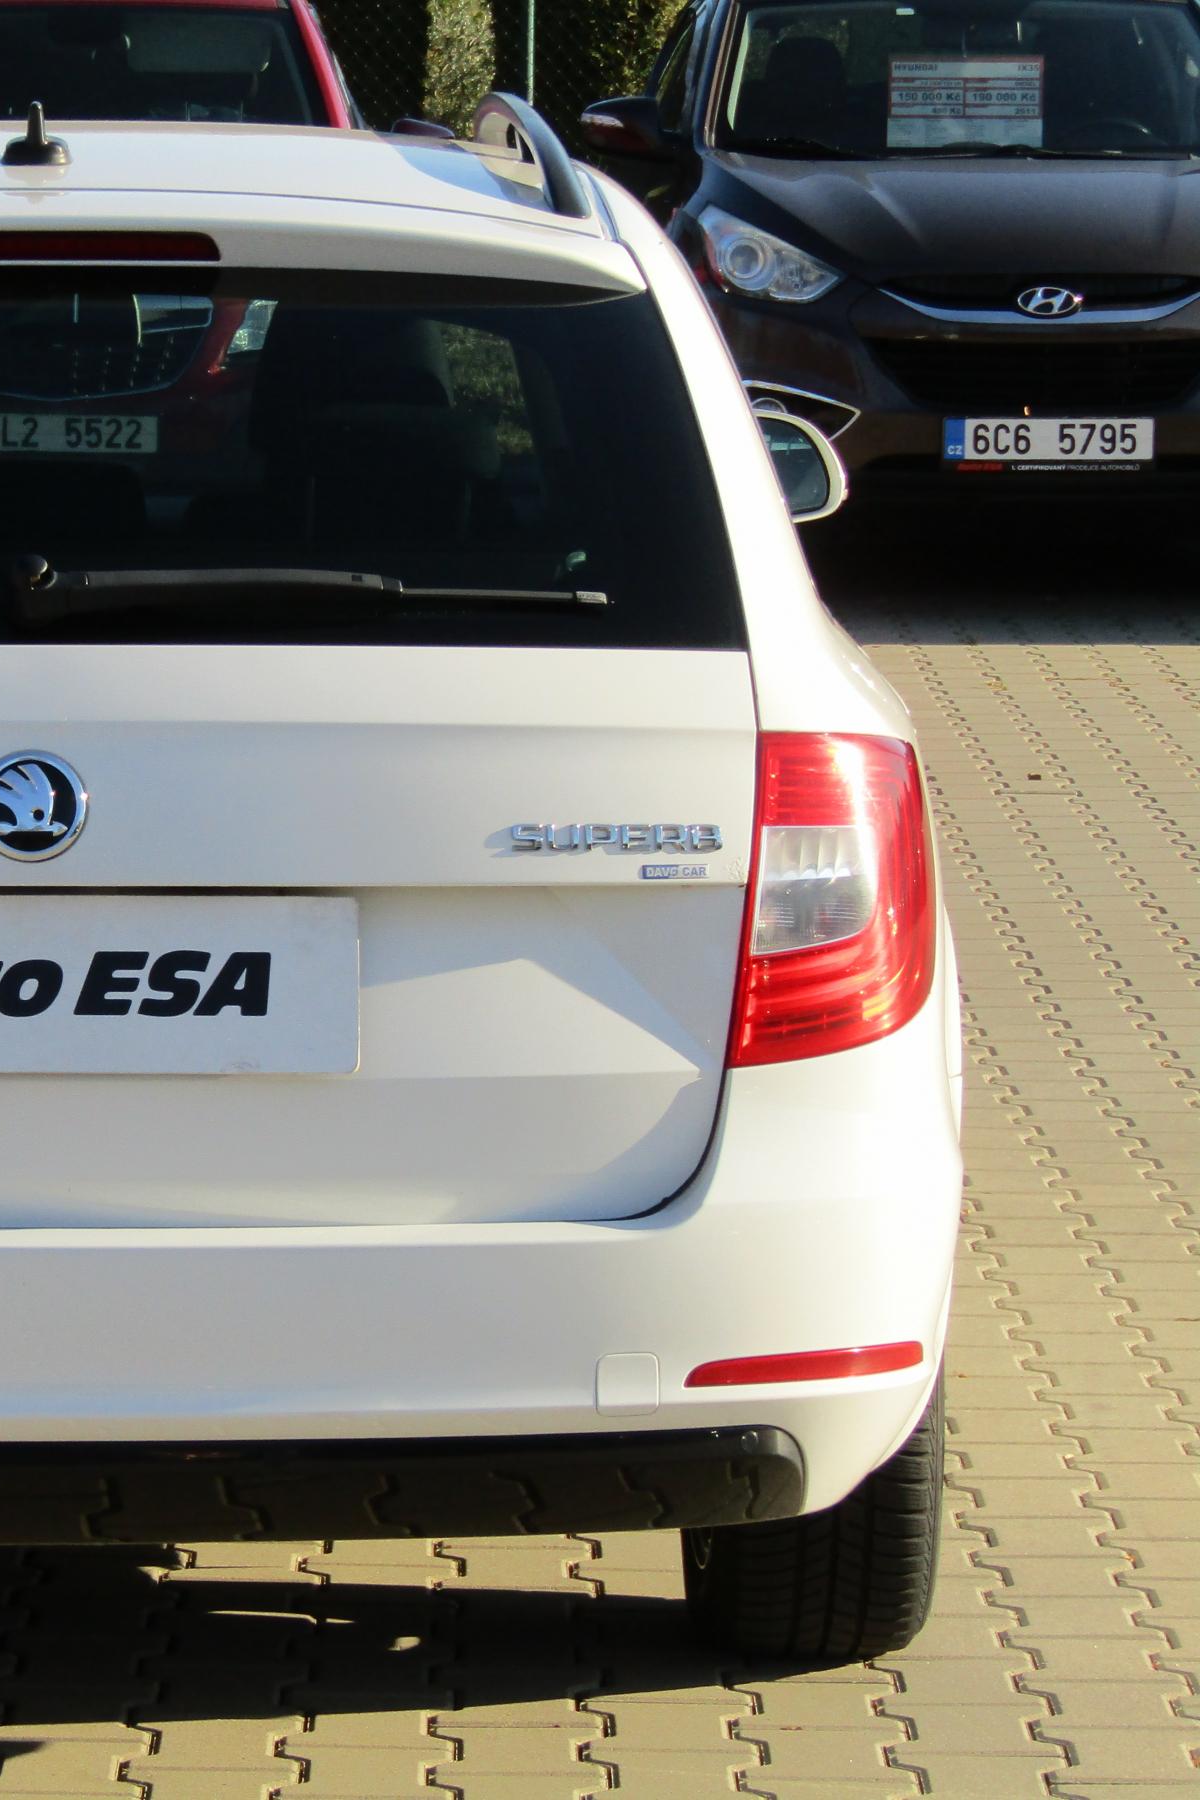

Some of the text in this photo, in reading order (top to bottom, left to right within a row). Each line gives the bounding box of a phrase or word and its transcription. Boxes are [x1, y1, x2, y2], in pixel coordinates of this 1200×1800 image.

[894, 63, 938, 72] HYUNDAI
[65, 418, 142, 449] 5522
[947, 424, 1137, 455] CZ 6C6 5795
[511, 823, 723, 851] SUPERB
[681, 866, 707, 877] CAR
[73, 949, 272, 1017] ESA
